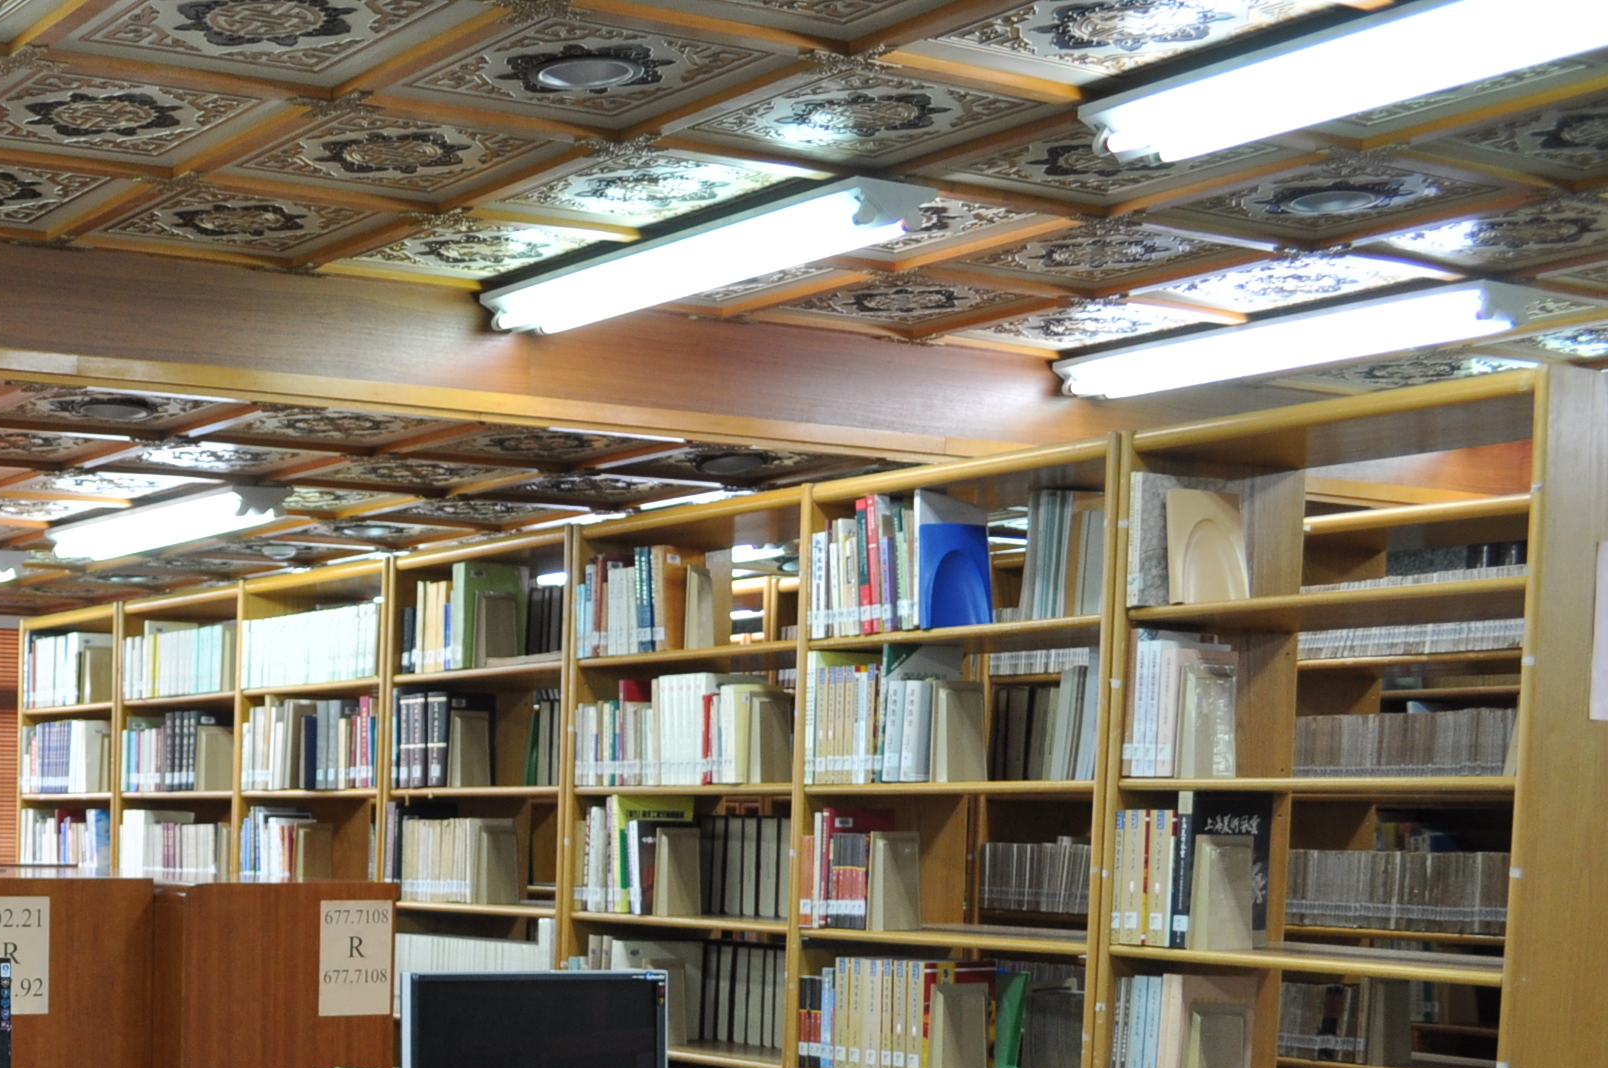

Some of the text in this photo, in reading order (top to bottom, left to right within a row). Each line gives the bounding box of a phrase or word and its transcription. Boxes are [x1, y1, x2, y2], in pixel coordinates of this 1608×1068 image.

[324, 908, 389, 925] 677.7108
[1, 941, 21, 964] R
[347, 935, 365, 958] R
[323, 968, 388, 984] 677.7108
[14, 977, 43, 997] .92
